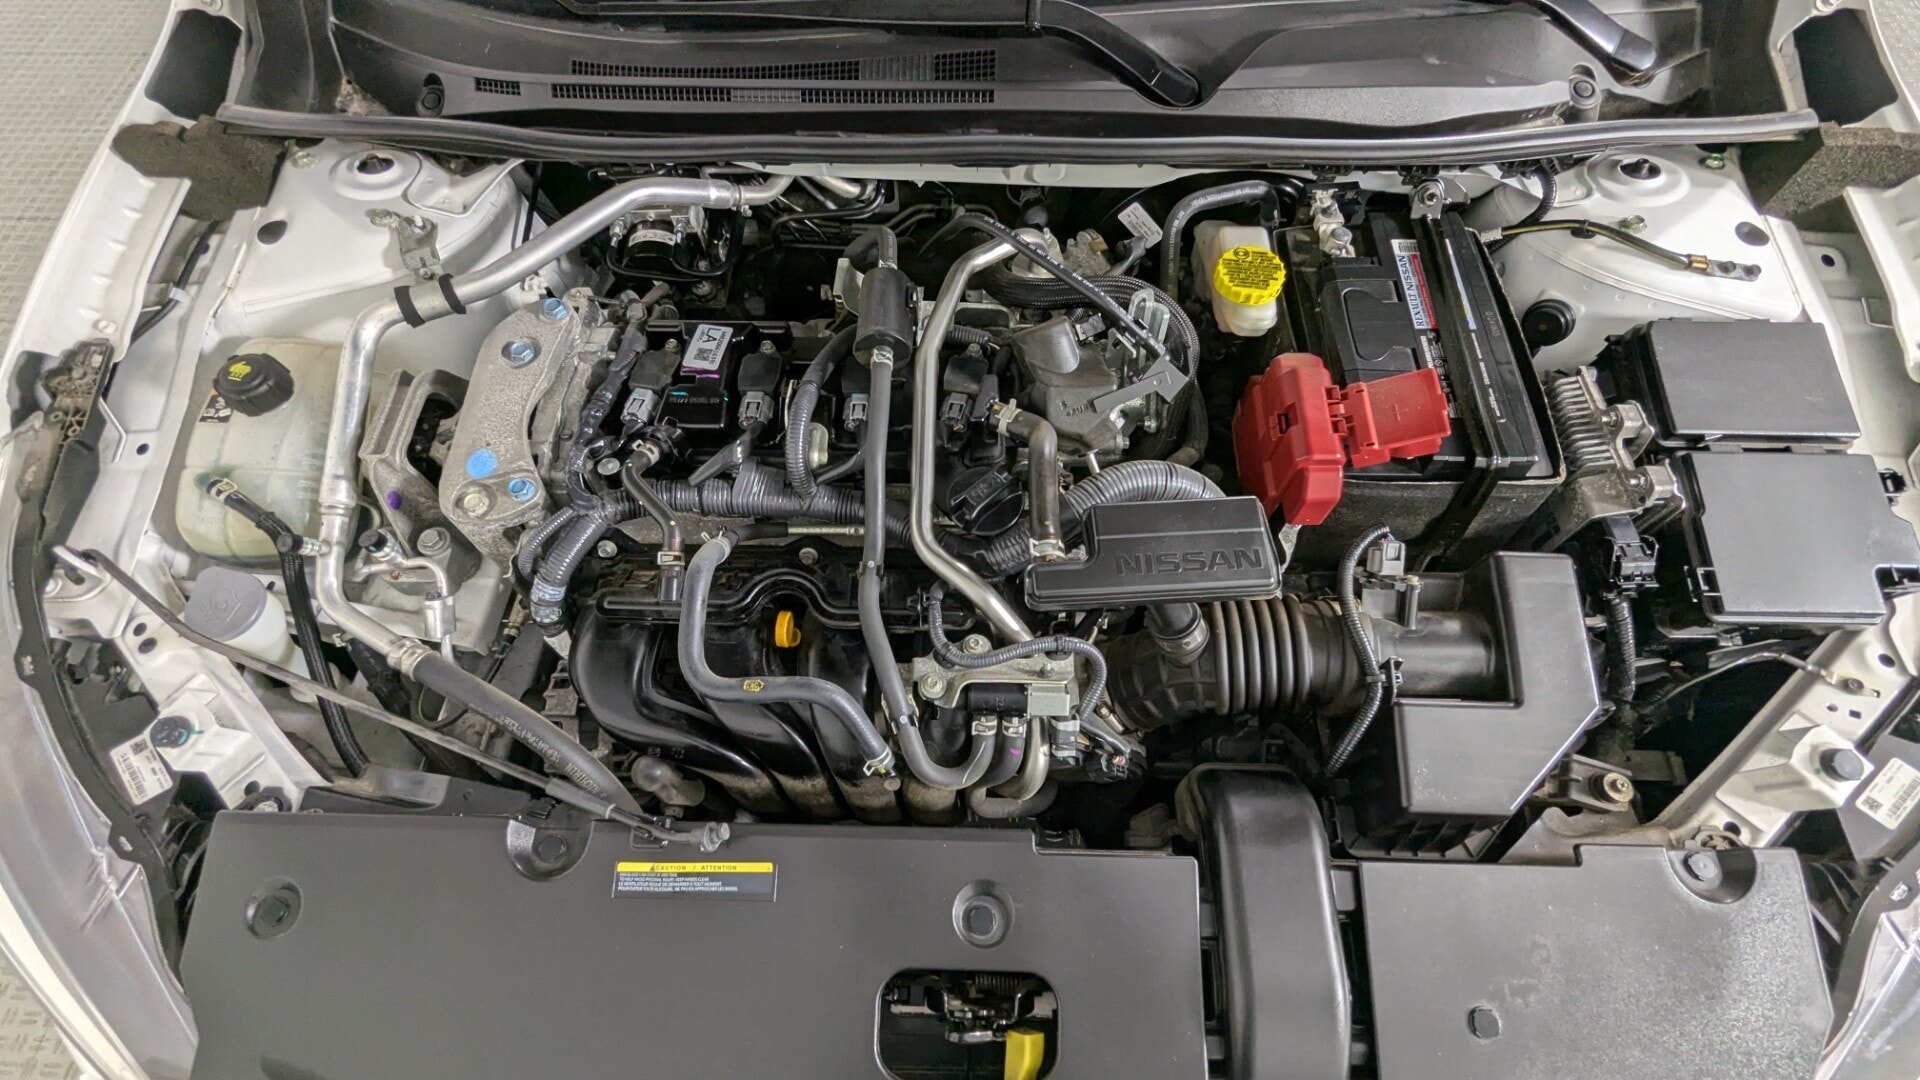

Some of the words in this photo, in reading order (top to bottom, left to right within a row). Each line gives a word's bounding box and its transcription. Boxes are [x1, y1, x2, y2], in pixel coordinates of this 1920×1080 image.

[1398, 255, 1416, 291] NISSAN
[1408, 292, 1426, 327] RENAULT
[702, 327, 722, 343] LA
[1115, 548, 1264, 576] NISSAN
